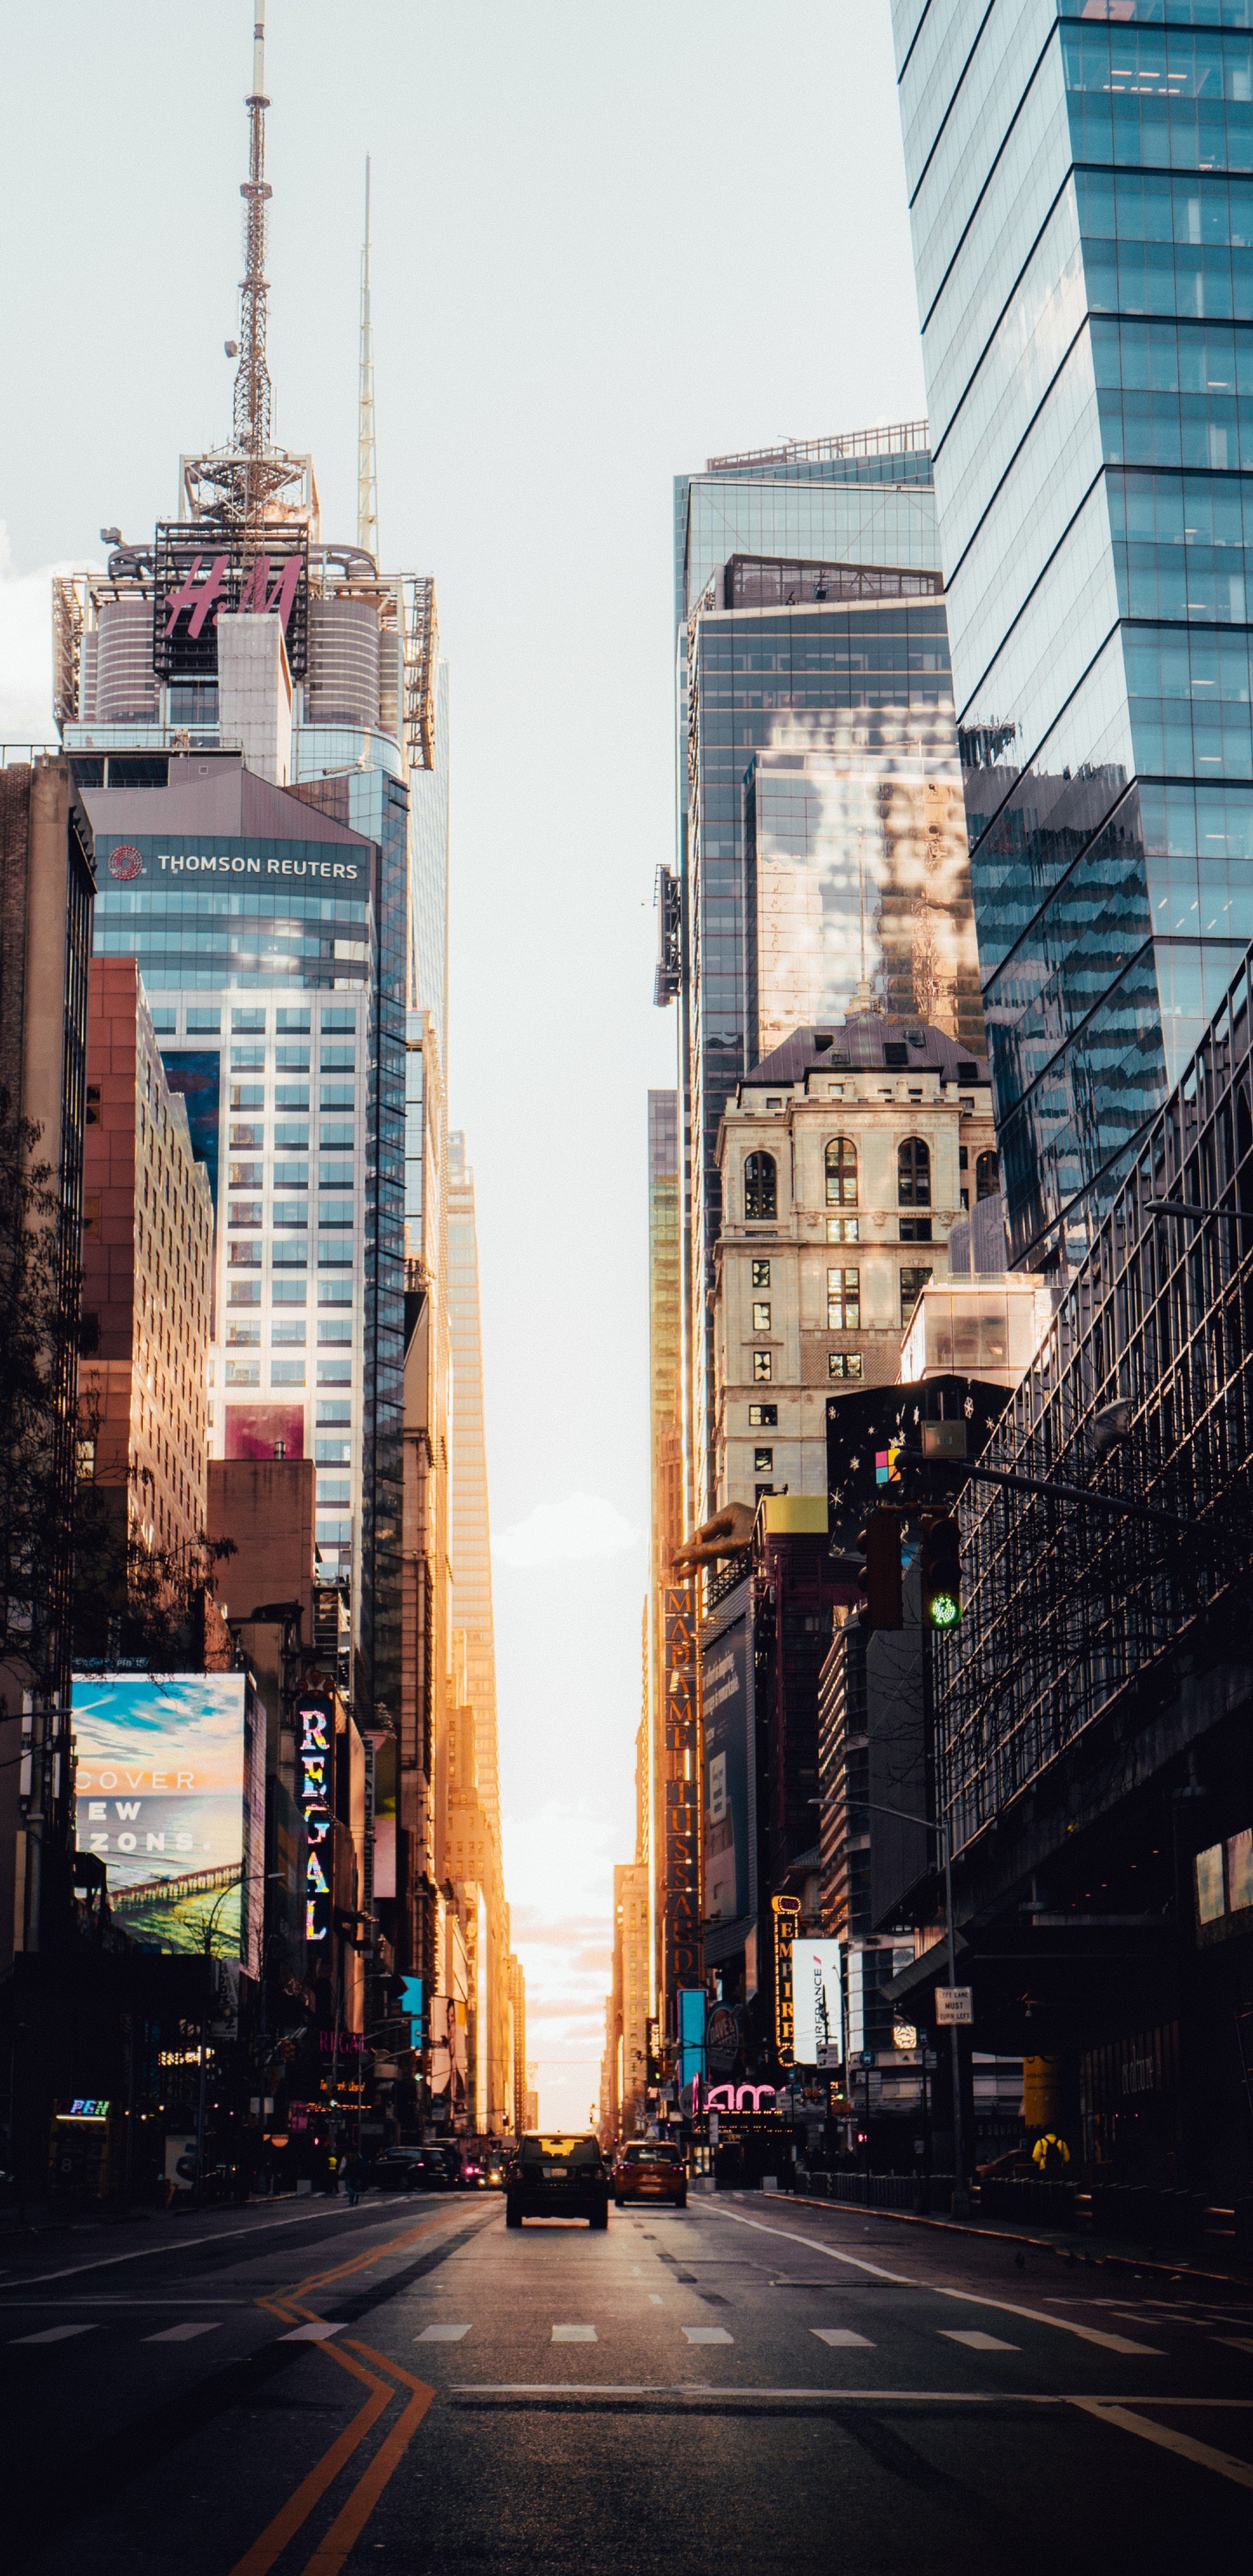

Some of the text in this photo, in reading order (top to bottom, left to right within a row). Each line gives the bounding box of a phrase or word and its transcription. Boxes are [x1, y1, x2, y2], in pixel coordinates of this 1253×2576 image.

[157, 855, 358, 880] THOMSON REUTERS
[667, 1590, 694, 1749] MADAME
[77, 1770, 194, 1790] COVER
[299, 1709, 331, 1941] REGAL
[779, 1922, 794, 2038] EMPIRE
[57, 2097, 111, 2116] OPEN
[703, 2084, 787, 2110] am
